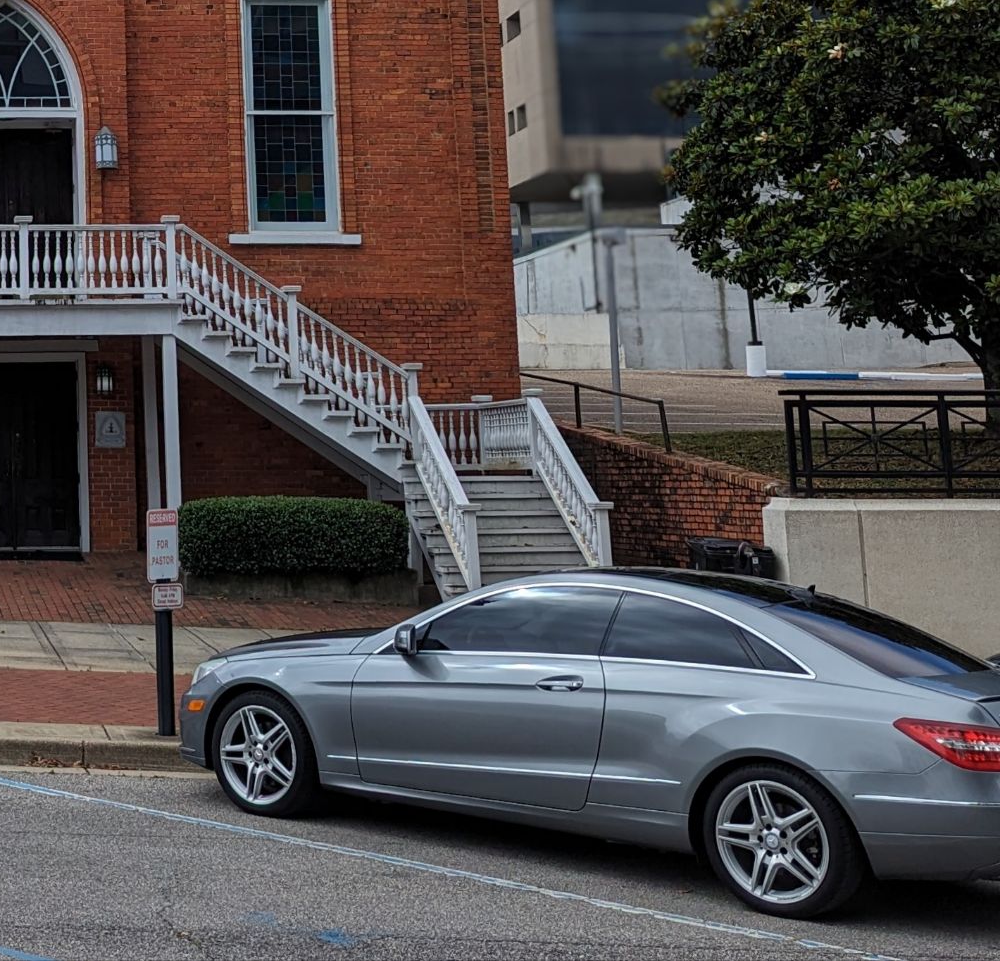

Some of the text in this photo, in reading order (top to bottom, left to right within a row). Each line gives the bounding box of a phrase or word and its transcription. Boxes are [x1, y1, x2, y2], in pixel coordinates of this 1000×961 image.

[149, 513, 176, 523] RESERVED
[156, 539, 169, 550] FOR
[151, 556, 175, 566] PASTOR
